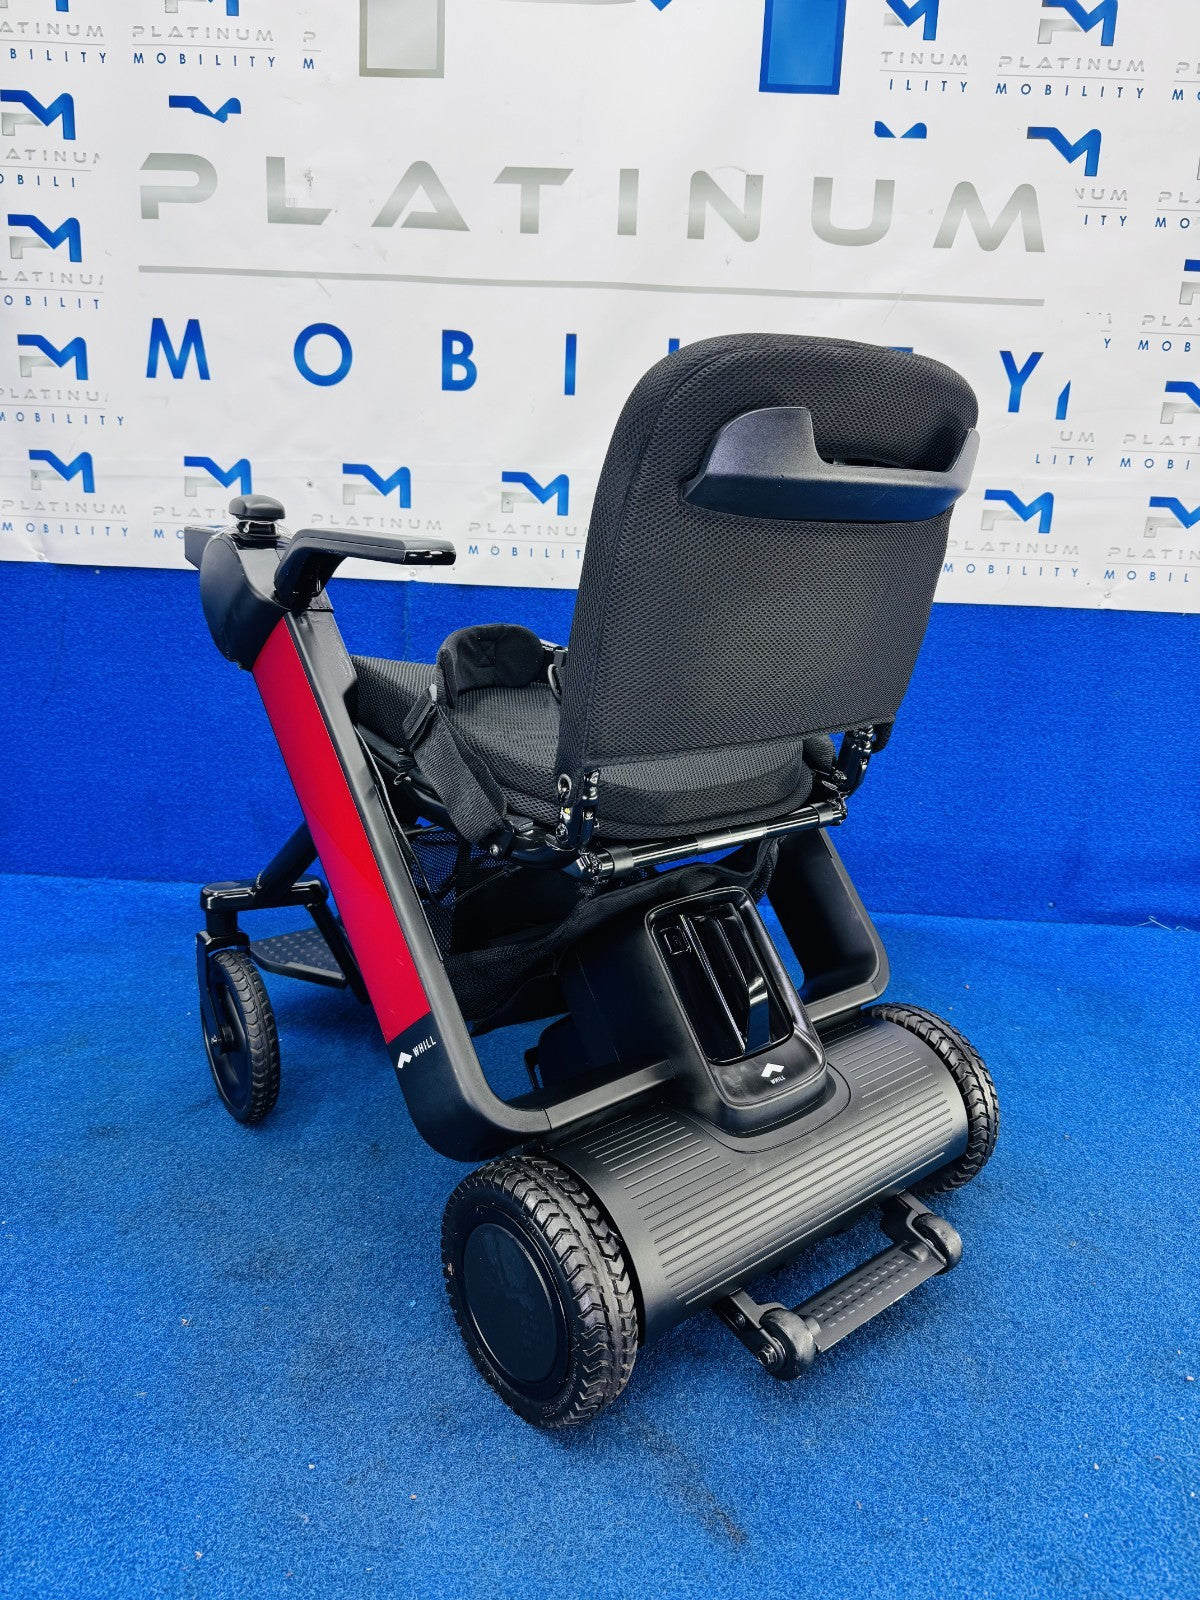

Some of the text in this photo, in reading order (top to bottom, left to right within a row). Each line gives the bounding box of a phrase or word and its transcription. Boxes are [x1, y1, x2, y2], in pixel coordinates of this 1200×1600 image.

[132, 25, 274, 42] PLATINUM
[133, 52, 276, 68] MOBILITY
[881, 51, 968, 67] TINUM
[998, 55, 1146, 73] PLATINUM
[889, 78, 968, 93] ILITY
[995, 82, 1145, 99] MOBILITY
[138, 152, 1046, 253] PLATINUM
[146, 317, 1044, 413] MOBIY
[1035, 453, 1094, 466] LITY
[2, 499, 127, 515] PLATINUM
[2, 521, 129, 537] MOBILITY
[311, 513, 443, 531] PLATINUM
[943, 562, 1079, 578] MOBILITY
[412, 1035, 437, 1058] WHILL
